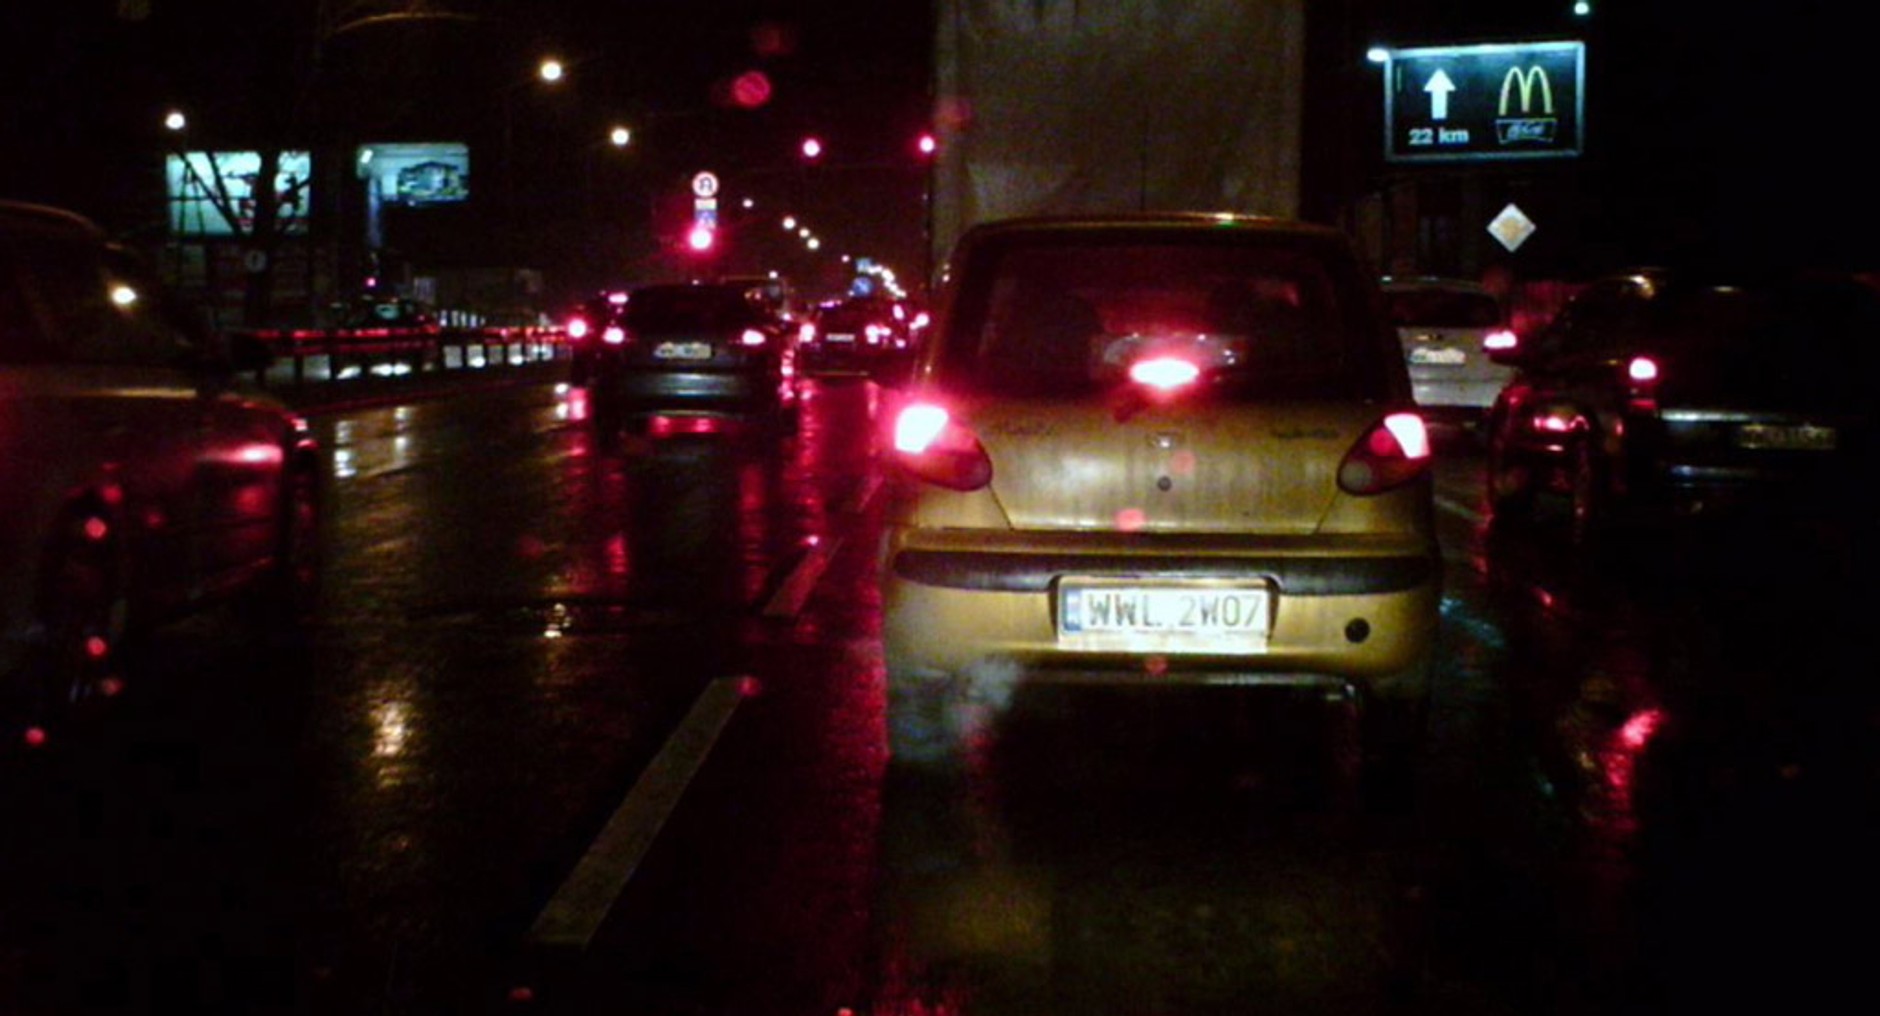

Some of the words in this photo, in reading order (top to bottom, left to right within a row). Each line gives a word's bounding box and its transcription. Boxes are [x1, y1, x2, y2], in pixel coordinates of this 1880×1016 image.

[1408, 127, 1434, 145] 22
[1438, 126, 1470, 144] km
[1088, 593, 1157, 627] WWL
[1178, 594, 1262, 627] 2W07
